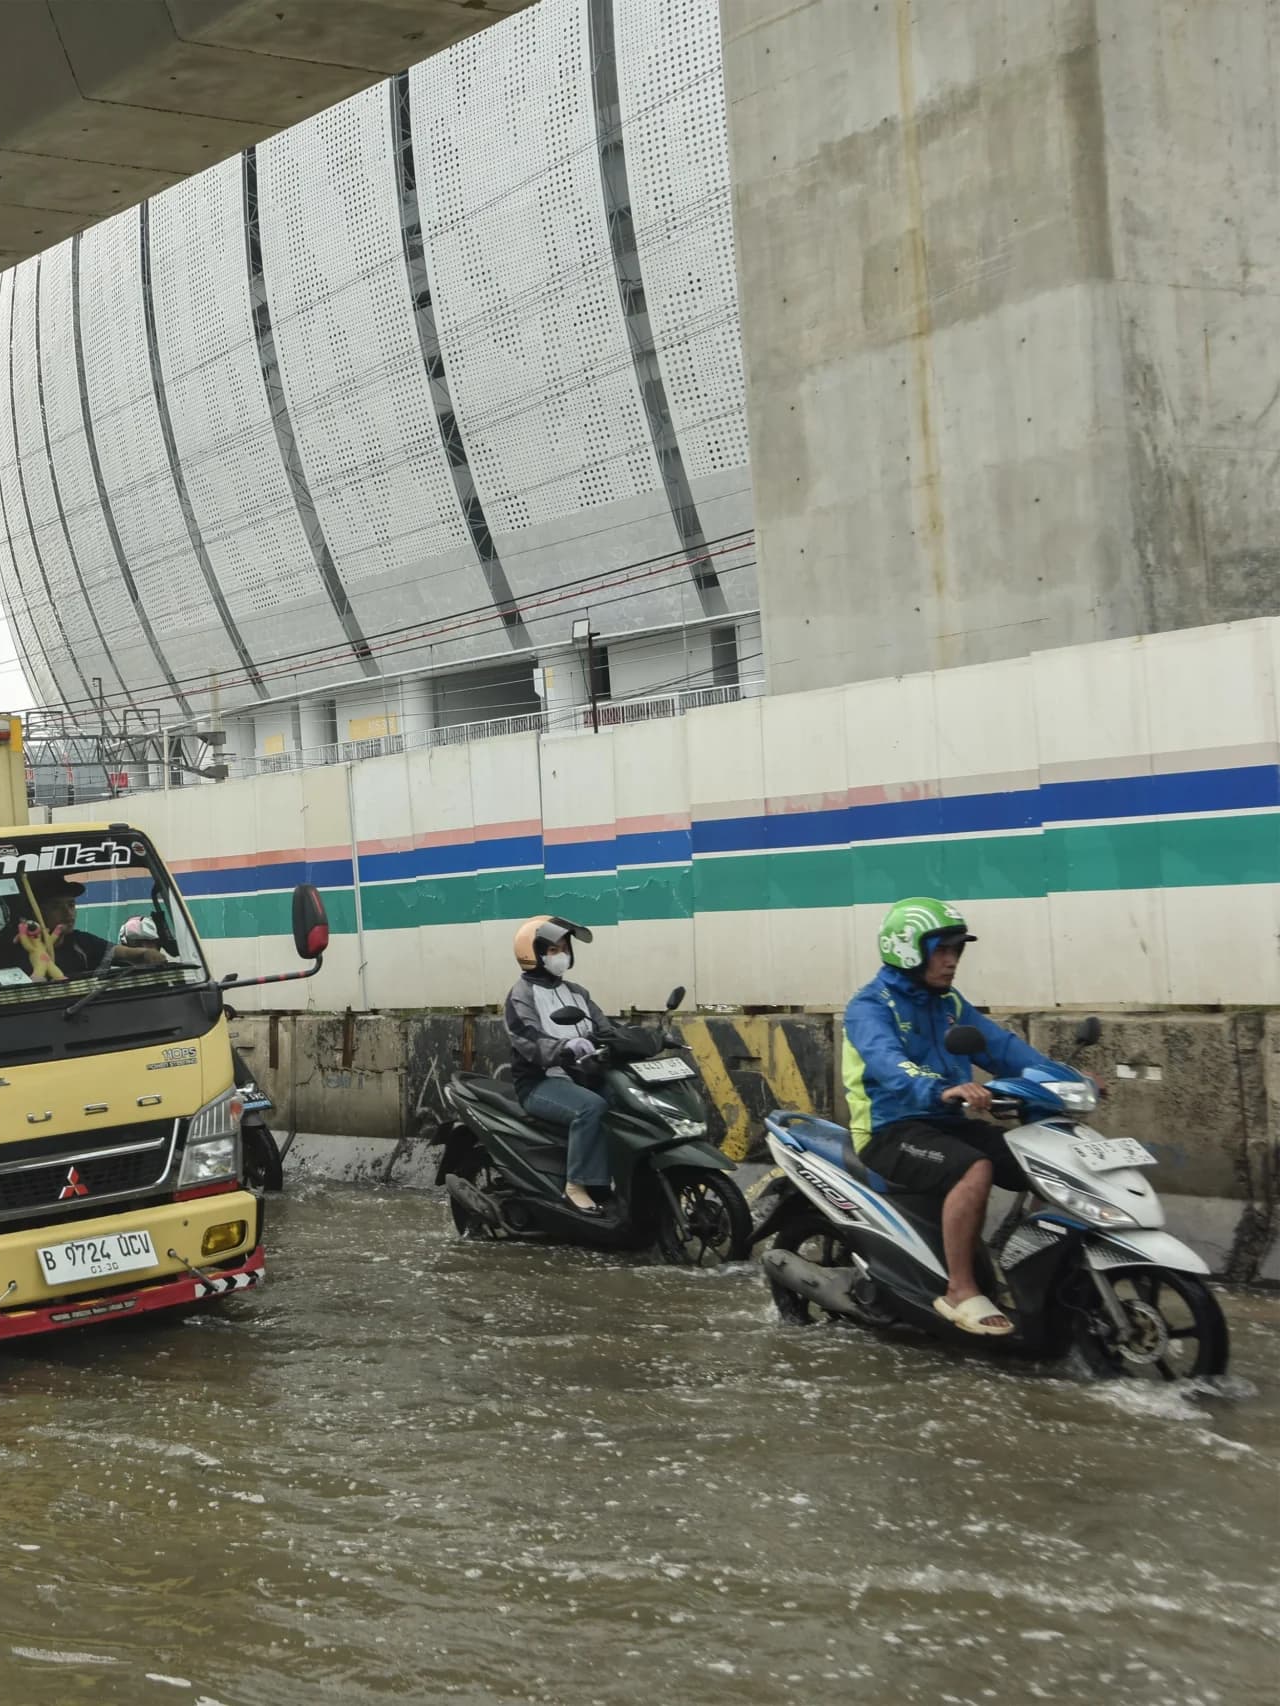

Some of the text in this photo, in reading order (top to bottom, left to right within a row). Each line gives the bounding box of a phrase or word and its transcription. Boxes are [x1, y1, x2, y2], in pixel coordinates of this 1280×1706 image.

[42, 1233, 150, 1271] B 9724 UCV
